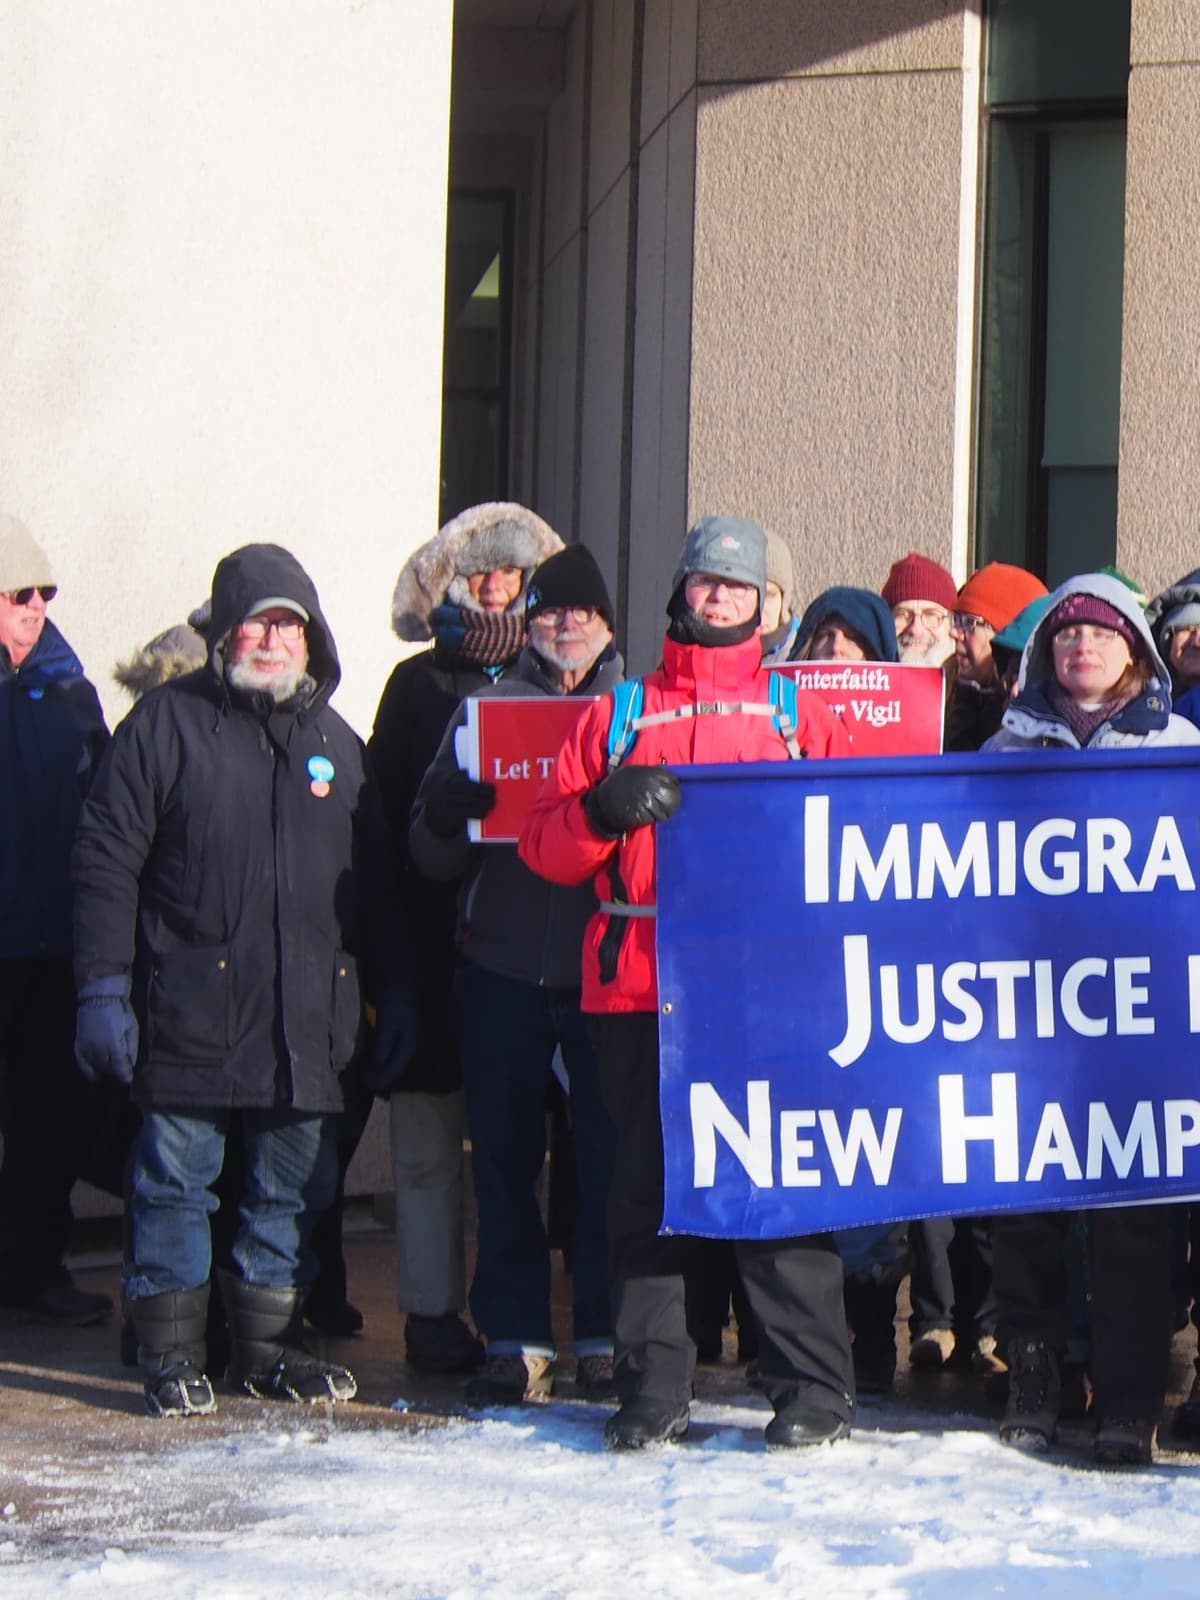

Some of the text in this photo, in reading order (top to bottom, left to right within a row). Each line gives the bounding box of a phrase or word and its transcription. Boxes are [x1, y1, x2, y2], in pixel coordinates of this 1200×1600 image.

[794, 668, 890, 692] Interfaith
[850, 700, 902, 727] Vigil
[493, 757, 531, 780] Let
[828, 933, 1155, 1068] JUSTICE
[689, 1079, 903, 1189] NEW
